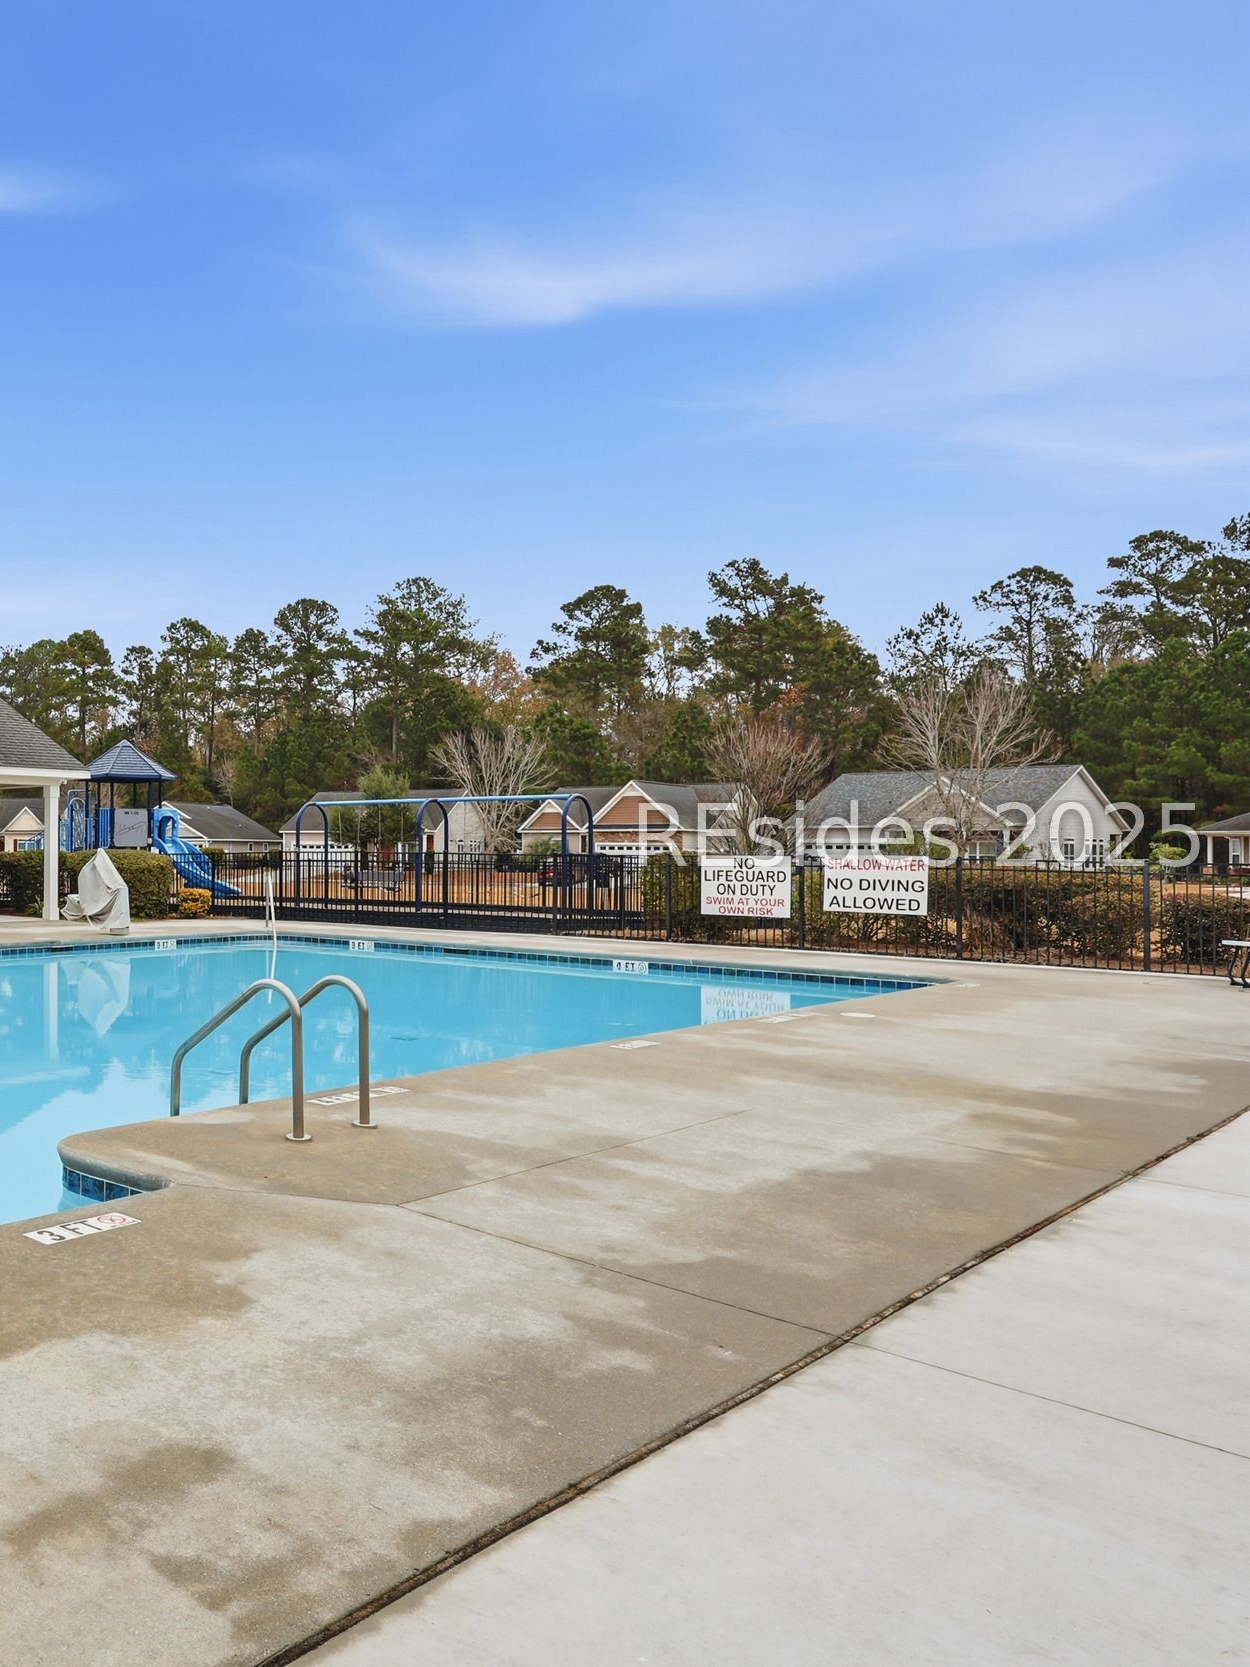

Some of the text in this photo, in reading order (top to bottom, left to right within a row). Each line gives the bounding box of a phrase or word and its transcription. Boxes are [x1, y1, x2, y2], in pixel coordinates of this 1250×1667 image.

[733, 857, 755, 870] NO
[827, 858, 926, 872] SHALLOW WATER
[704, 870, 787, 883] LIFEGUARD
[716, 883, 777, 897] ON DUTY
[826, 877, 925, 893] NO DIVING
[705, 896, 785, 908] SWIM AT YOUR
[828, 895, 921, 912] ALLOWED
[718, 905, 774, 916] OWN RISK
[37, 1230, 67, 1241] 3
[60, 1220, 103, 1235] FT
